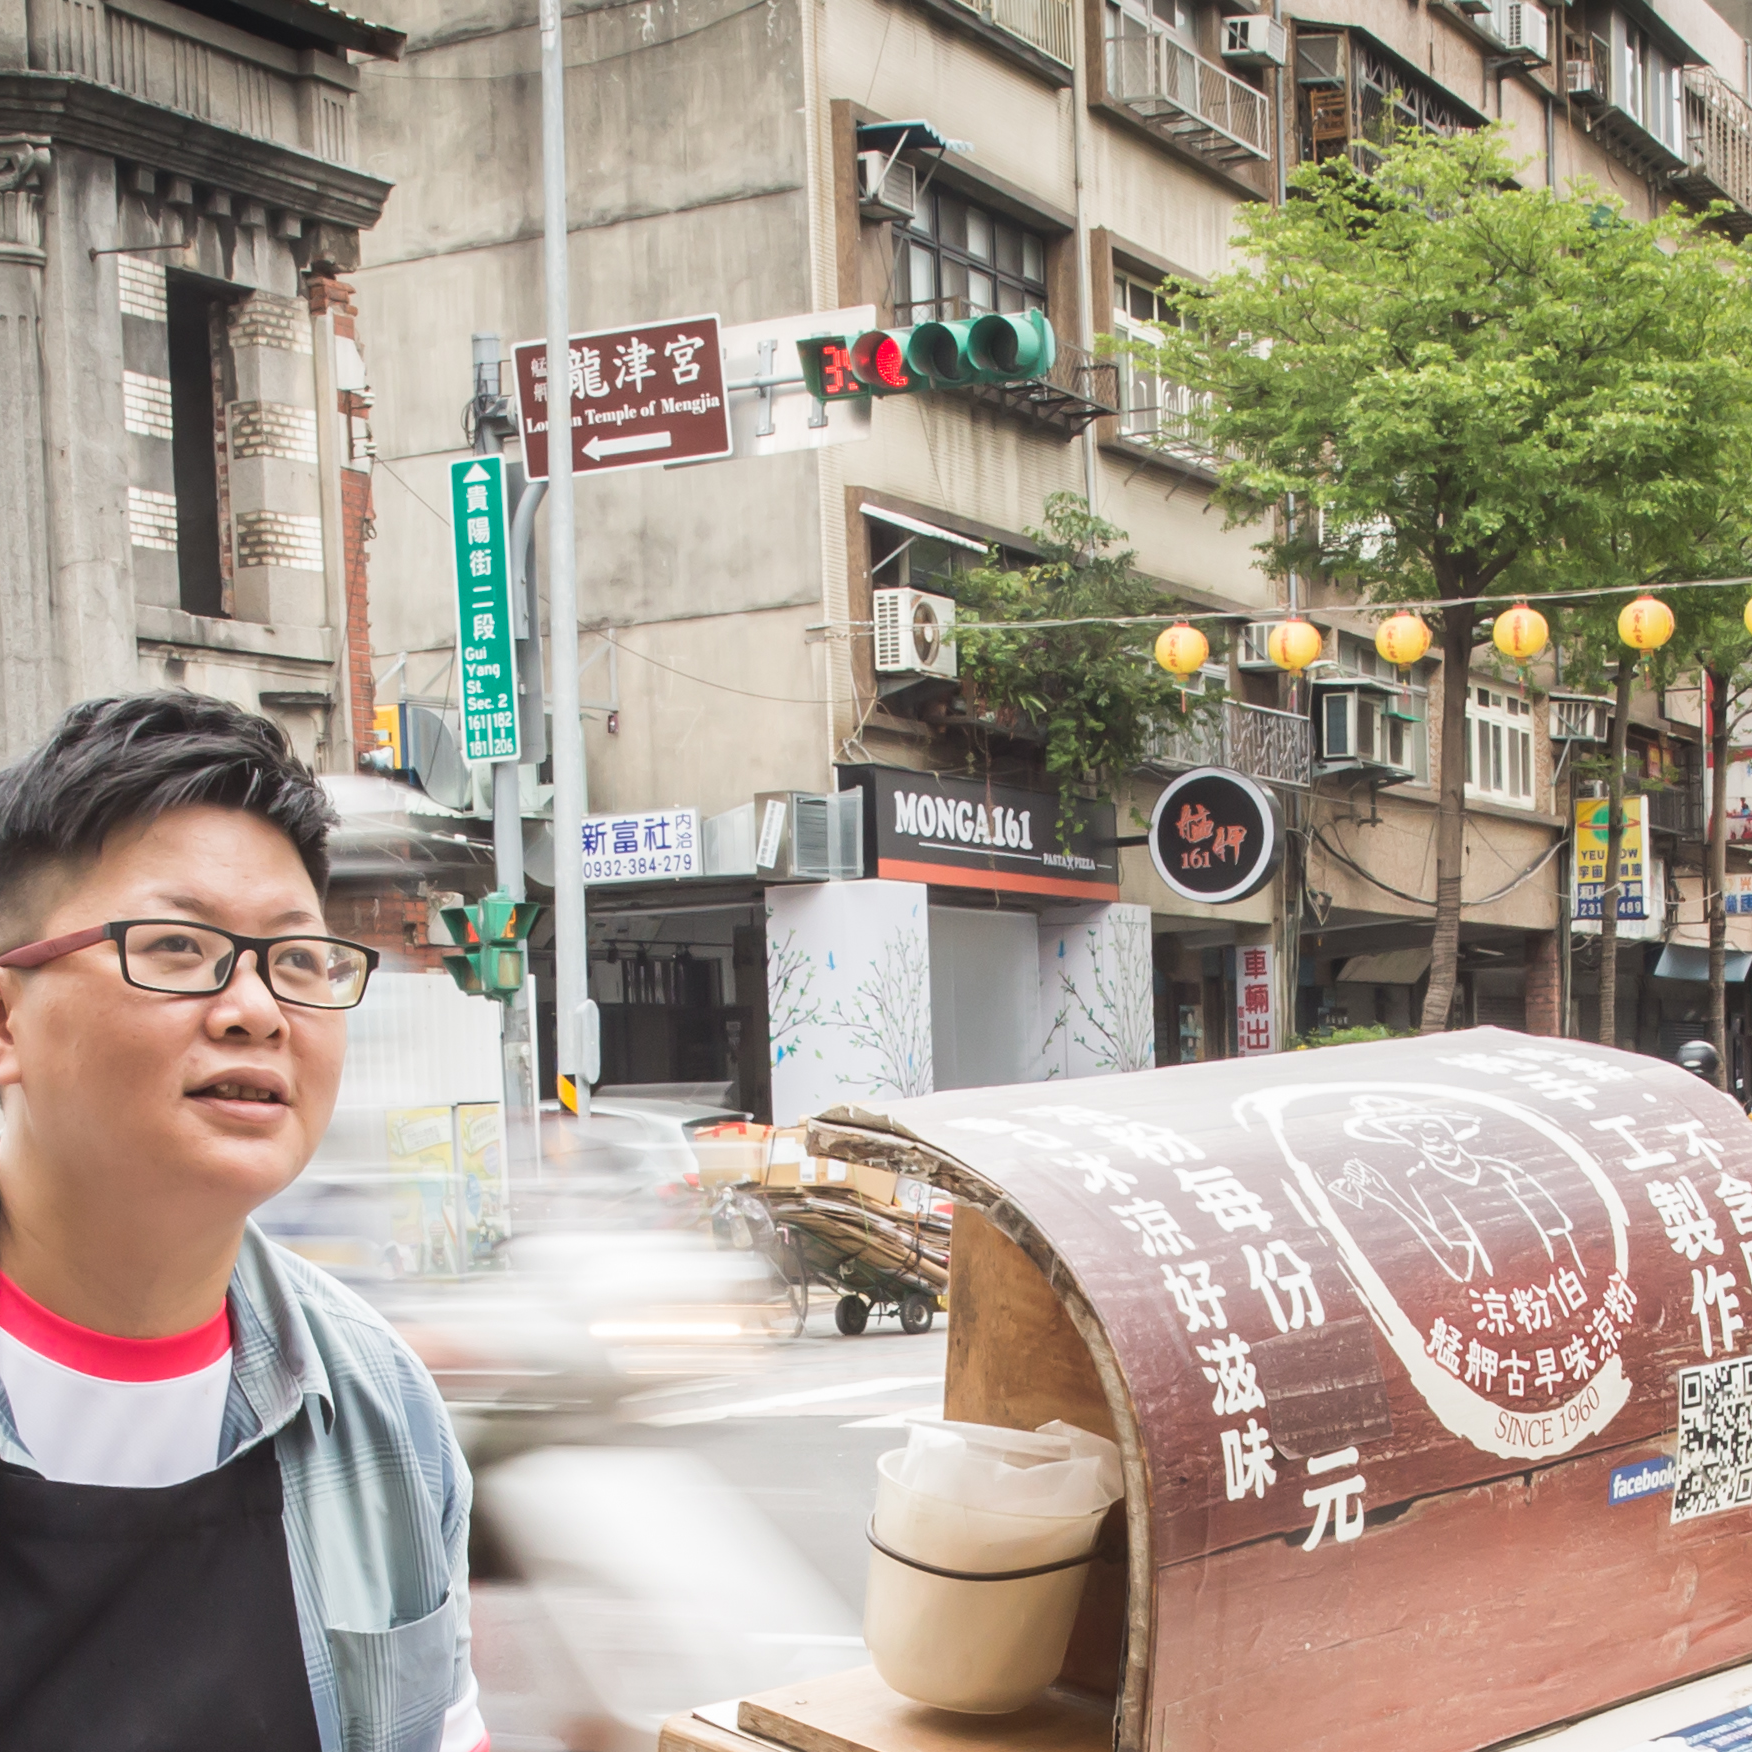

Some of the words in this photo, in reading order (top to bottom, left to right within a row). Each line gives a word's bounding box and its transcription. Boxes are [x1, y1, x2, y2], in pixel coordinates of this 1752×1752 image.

[584, 403, 637, 426] Temple
[640, 400, 657, 418] of
[661, 393, 721, 415] Mengjia
[465, 484, 496, 642] 貴陽街二段
[464, 646, 488, 661] Gui
[465, 663, 501, 679] Yang
[466, 680, 485, 695] St.
[467, 696, 494, 711] Sec.
[497, 693, 509, 709] 2
[467, 714, 487, 731] 161
[492, 711, 513, 728] 182
[469, 740, 488, 757] 181
[494, 737, 515, 755] 206
[893, 790, 1034, 851] MONGA161
[581, 815, 673, 857] 新富社
[583, 853, 693, 879] 0932-384-279
[1180, 847, 1212, 870] 161
[1468, 1266, 1589, 1337] 涼粉伯
[1494, 1411, 1554, 1448] SINCE
[1560, 1384, 1601, 1439] 1960
[1612, 1461, 1677, 1500] facebook
[1302, 1446, 1367, 1552] 元
